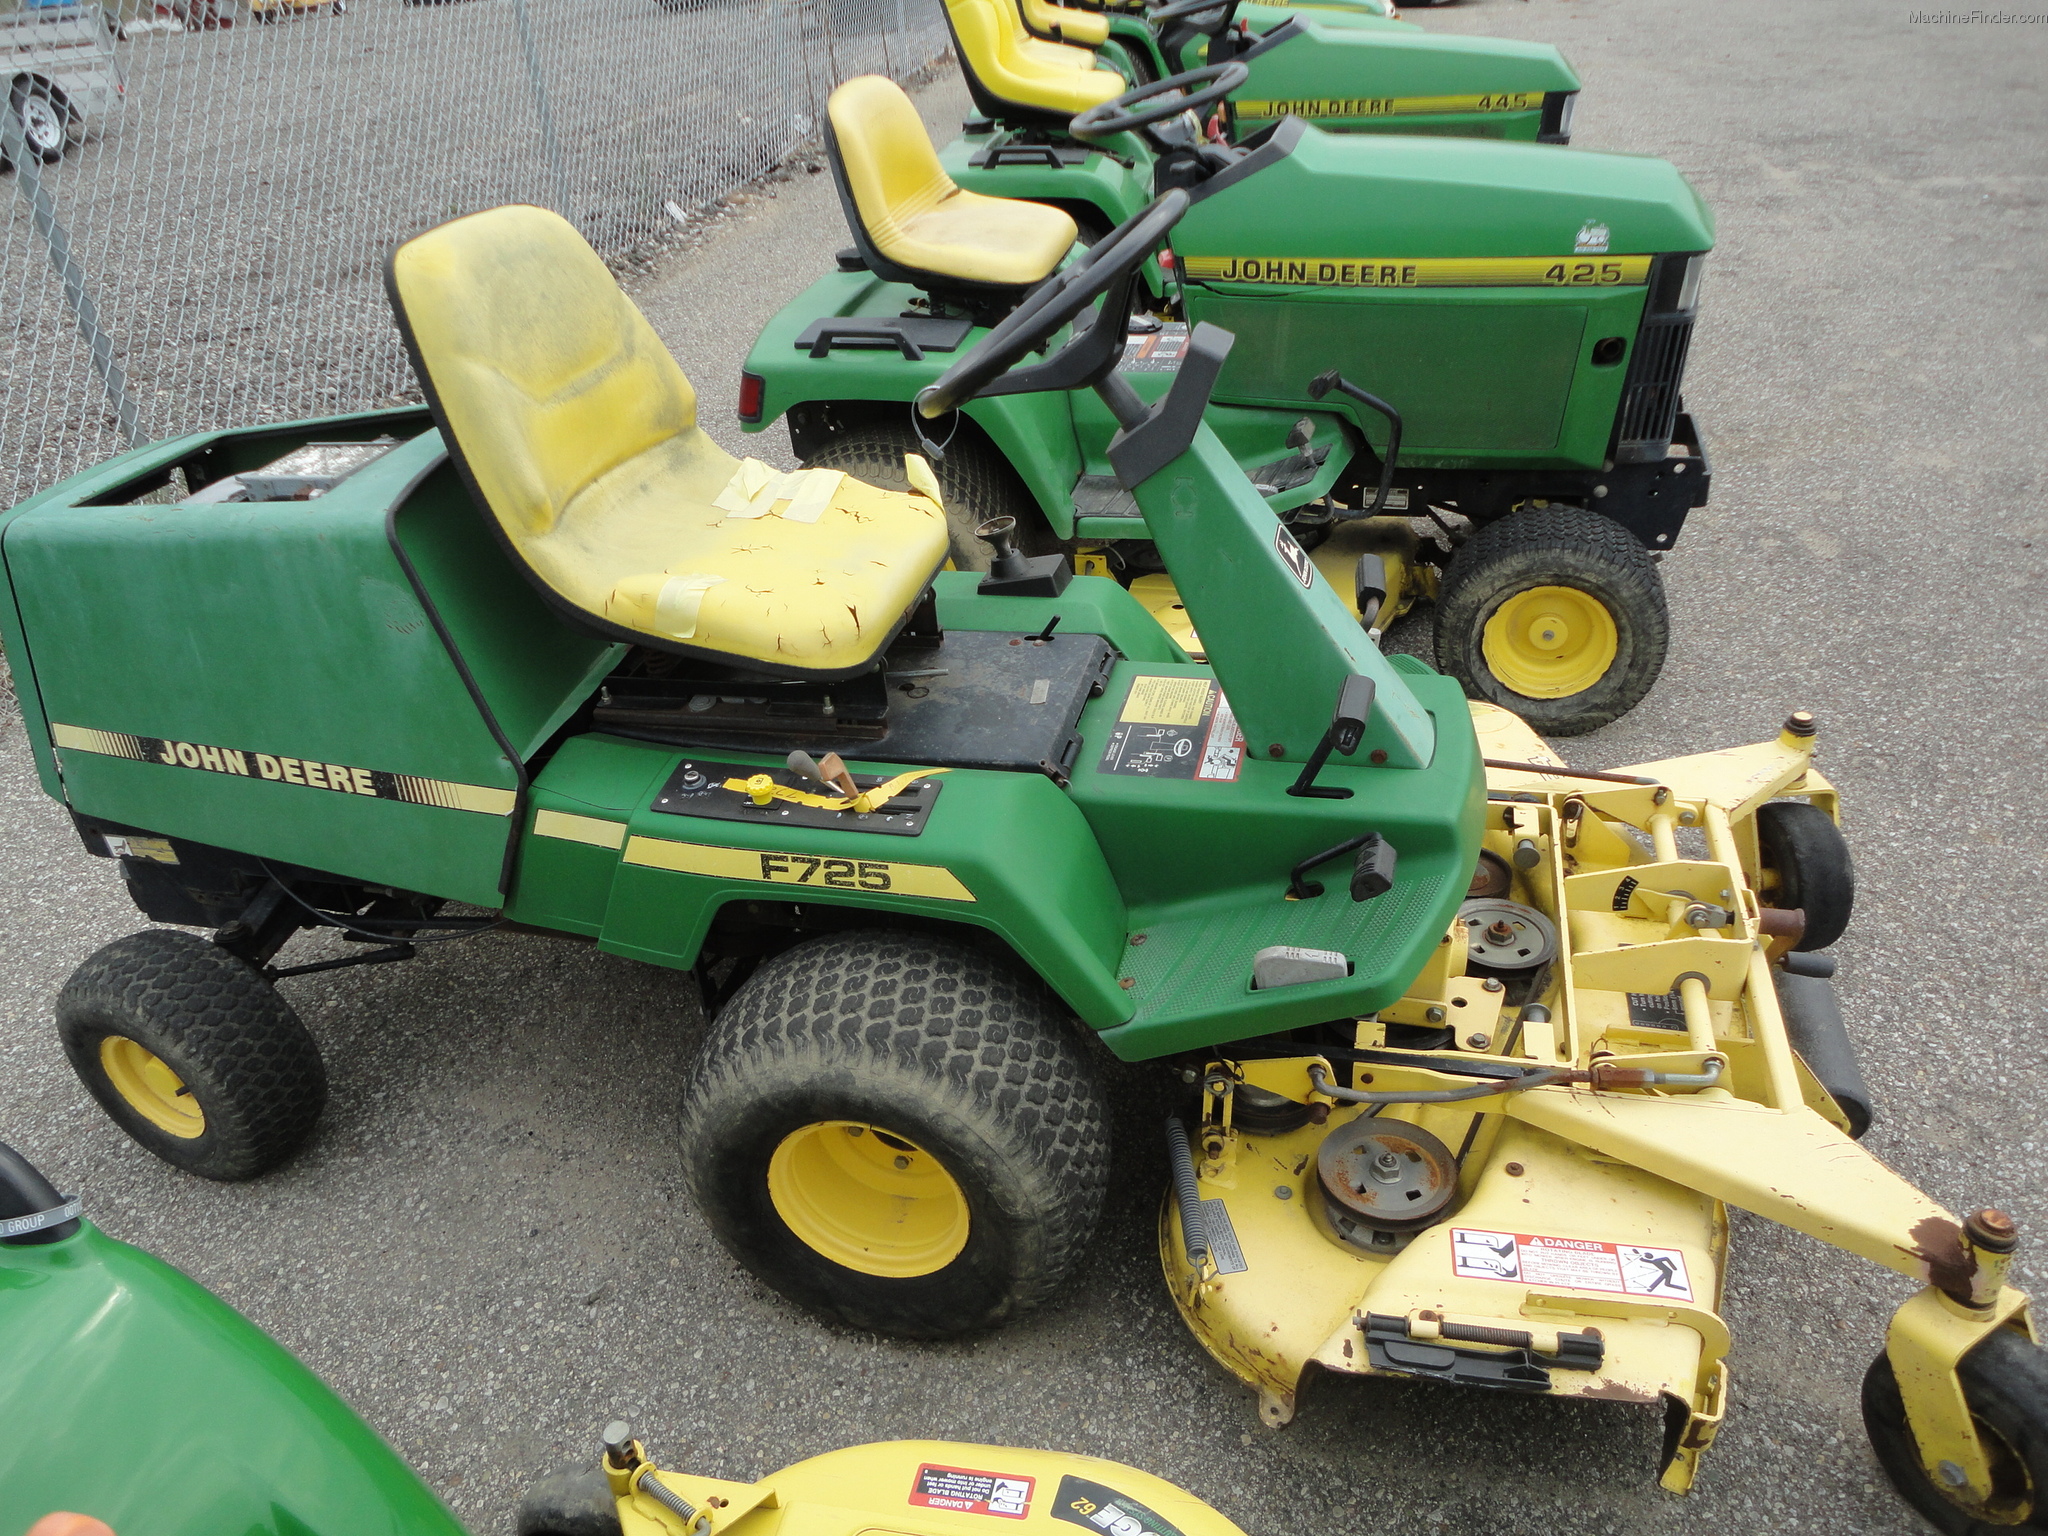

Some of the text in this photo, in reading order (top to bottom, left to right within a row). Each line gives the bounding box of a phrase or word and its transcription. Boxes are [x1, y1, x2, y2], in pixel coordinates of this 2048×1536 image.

[1262, 98, 1394, 118] JOHN DEERE
[1478, 94, 1528, 111] 445
[1222, 259, 1417, 286] JOHN DEERE
[1544, 262, 1624, 286] 425
[1202, 694, 1216, 717] CAUTION
[160, 740, 377, 796] JOHN DEERE
[760, 854, 891, 891] F725
[8, 1214, 45, 1233] GROUP
[1544, 1238, 1604, 1252] DANGER
[928, 1487, 984, 1500] ROTATING BLADE
[928, 1497, 964, 1509] DANGER
[1071, 1497, 1097, 1515] 62
